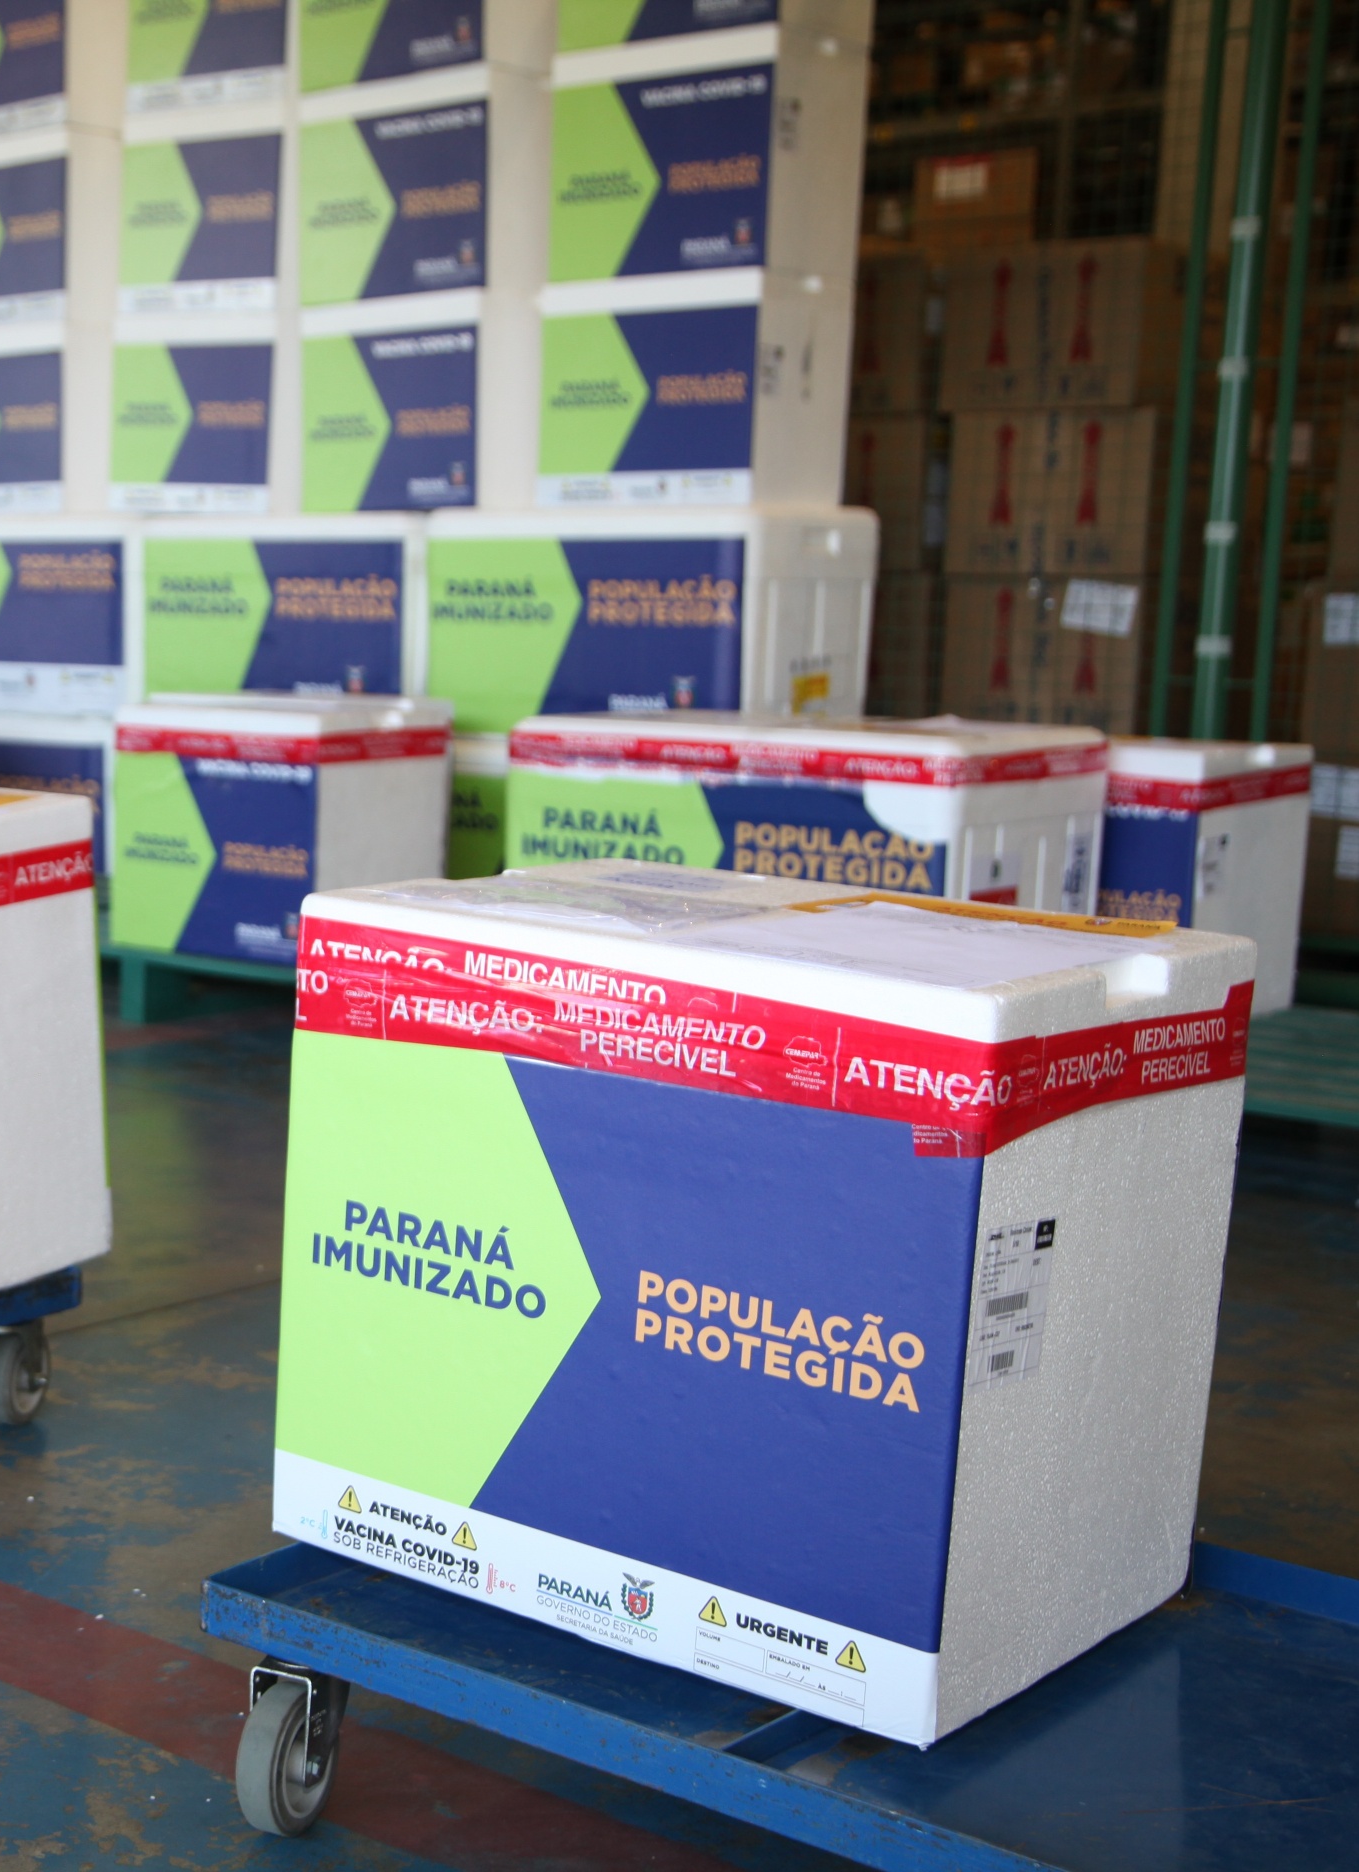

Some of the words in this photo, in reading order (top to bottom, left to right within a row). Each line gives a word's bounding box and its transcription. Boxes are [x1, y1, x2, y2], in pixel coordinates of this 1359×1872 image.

[445, 575, 536, 598] PARANÁ
[587, 574, 738, 601] POPULAÇÃO
[587, 600, 737, 626] PROTEGIDA
[543, 805, 662, 838] PARANÁ
[734, 820, 934, 862] POPULAÇÃO
[522, 832, 685, 865] IMUNIZADO
[733, 847, 932, 890] PROTEGIDA
[463, 950, 667, 1005] MEDICAMENTO
[389, 993, 543, 1036] ATENÇÃO:
[553, 1000, 766, 1051] MEDICAMENTO
[1133, 1017, 1226, 1055] MEDICAMENTO
[580, 1029, 737, 1078] PERECÍVEL
[1043, 1042, 1128, 1089] ATENÇÃO:
[1141, 1047, 1211, 1085] PERECÍVEL
[844, 1056, 1013, 1112] ATENÇÃO
[344, 1199, 515, 1271] PARANÁ
[312, 1232, 547, 1319] IMUNIZADO
[637, 1269, 925, 1369] POPULAÇÃO
[635, 1307, 920, 1413] PROTEGIDA
[369, 1501, 447, 1536] ATENÇÃO
[333, 1531, 361, 1550] SOB
[366, 1542, 480, 1589] REFRIGERAÇÃO
[334, 1515, 397, 1549] VACINA
[401, 1538, 480, 1575] COVID-19
[538, 1573, 612, 1611] PARANÁ
[536, 1595, 591, 1621] GOVERNO
[593, 1613, 610, 1627] DO
[613, 1620, 658, 1643] ESTADO
[556, 1614, 598, 1633] SECRETARIA
[598, 1628, 609, 1636] DA
[610, 1631, 633, 1646] SAÚDE
[698, 1630, 721, 1642] VOLUME
[736, 1612, 829, 1656] URGENTE
[696, 1657, 720, 1670] DESTINO
[769, 1653, 801, 1668] EMBALADO
